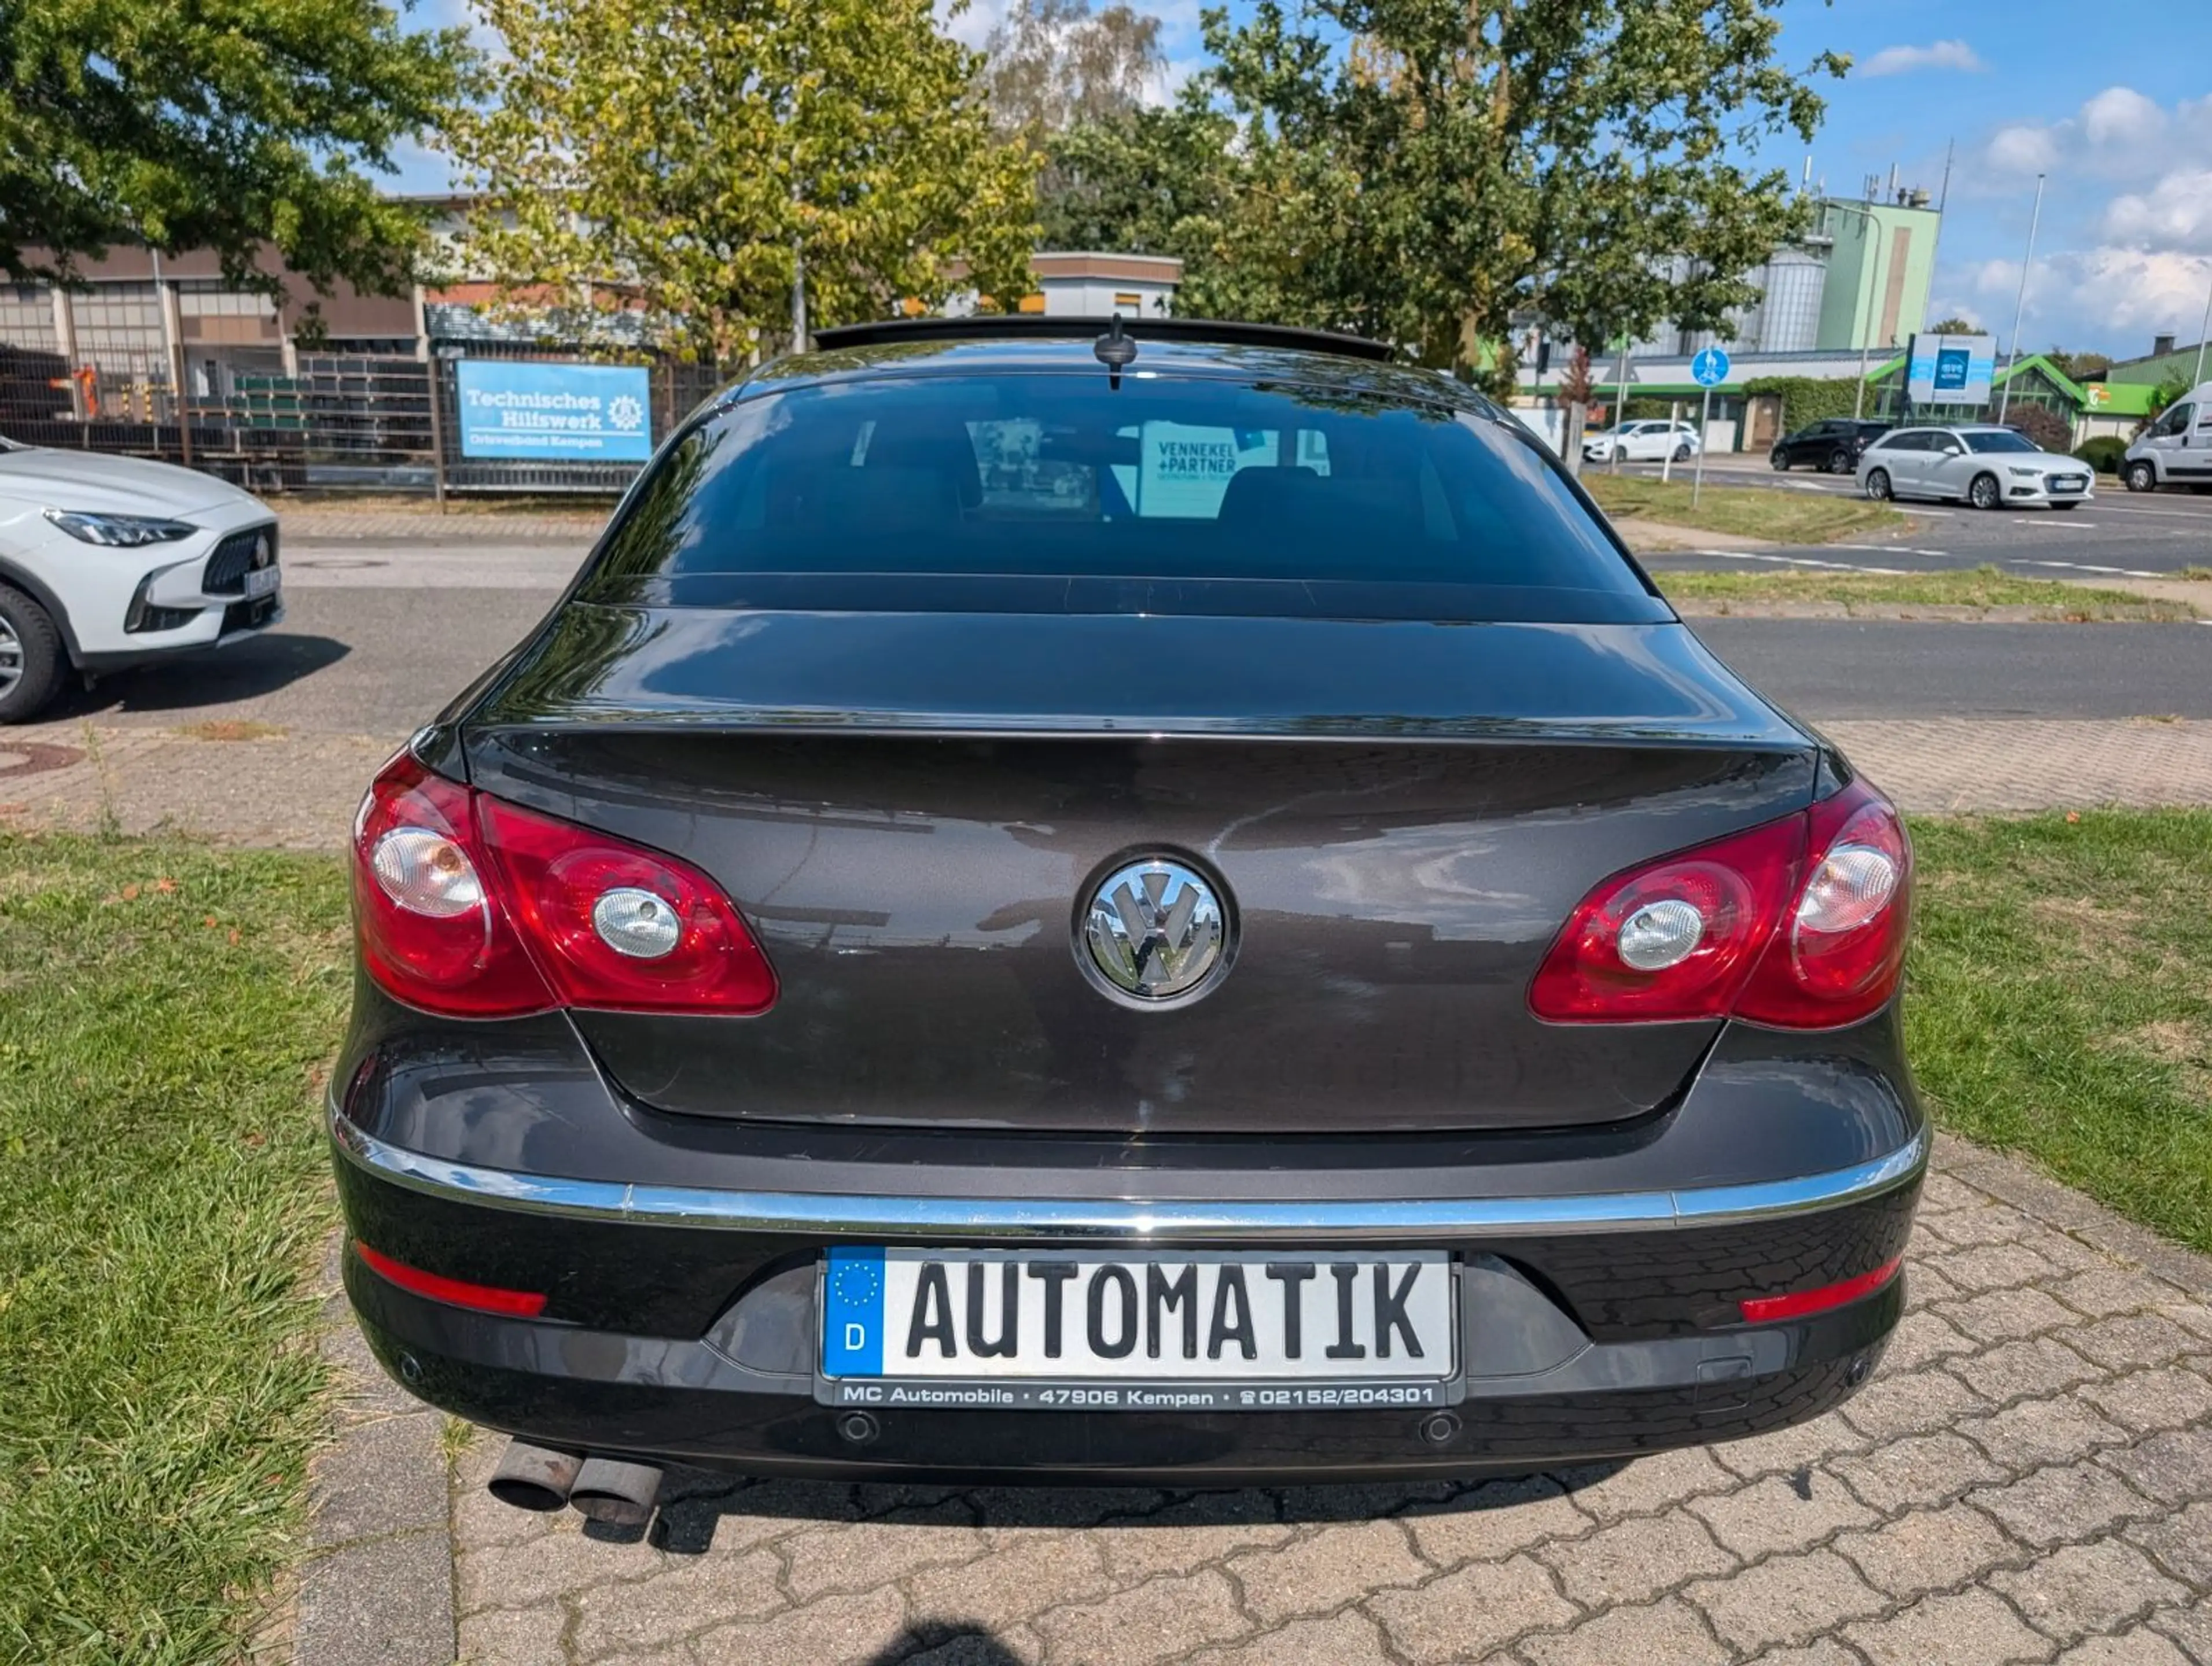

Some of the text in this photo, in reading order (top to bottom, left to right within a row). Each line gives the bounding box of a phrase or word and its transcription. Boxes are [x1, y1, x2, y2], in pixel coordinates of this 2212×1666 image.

[466, 389, 602, 410] Technisches
[502, 410, 602, 430] Hilfswerk
[1158, 442, 1234, 458] VENNEKEL
[845, 1260, 1425, 1359] D AUTOMATIK
[843, 1387, 1433, 1407] MC Automobile 47906 Kempen 02152/204301
